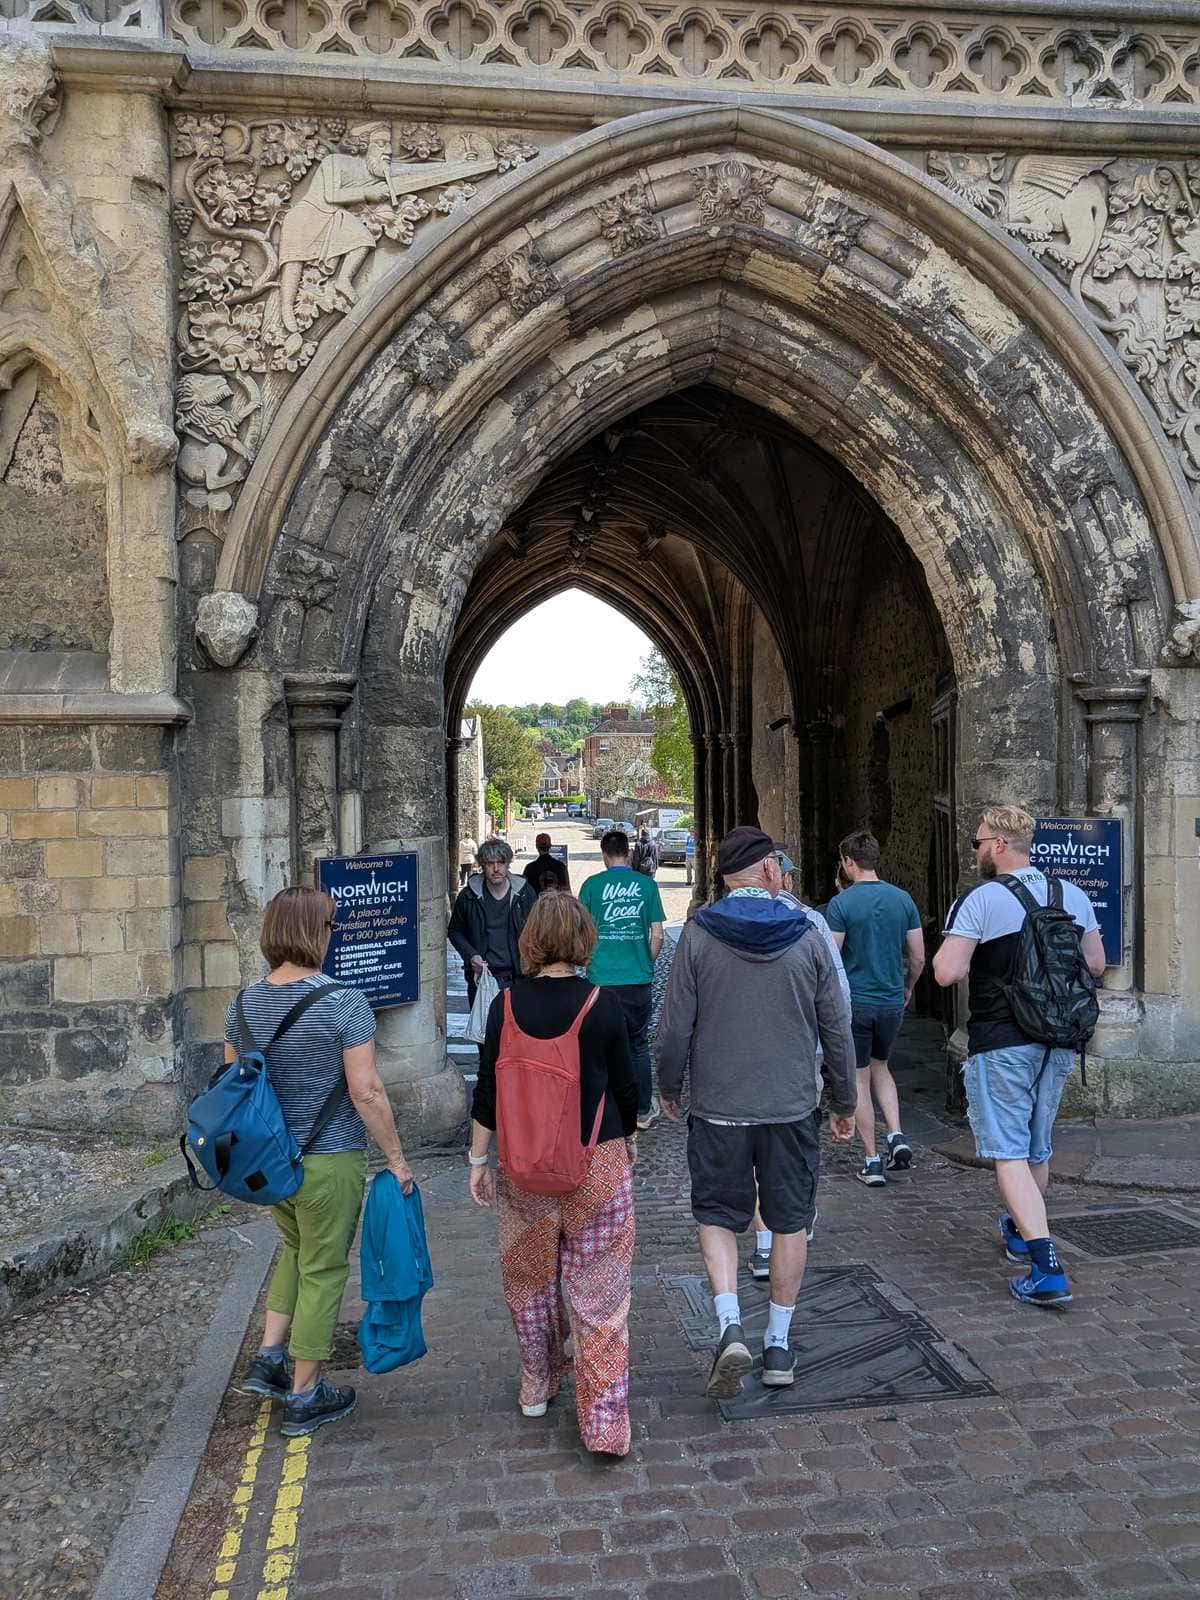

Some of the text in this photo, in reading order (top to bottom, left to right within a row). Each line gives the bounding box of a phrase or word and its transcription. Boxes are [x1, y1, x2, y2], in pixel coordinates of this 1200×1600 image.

[1040, 822, 1093, 831] Welcome to
[345, 859, 393, 871] Welcome to
[1029, 856, 1104, 865] CATHEDRAL
[1043, 866, 1091, 876] A place of
[331, 880, 409, 899] NORWICH
[1070, 878, 1109, 889] Worship
[602, 881, 642, 900] Walk
[335, 894, 404, 908] CATHEDRAL
[348, 906, 392, 919] A place of
[603, 900, 644, 921] Local
[333, 916, 408, 932] Christian Worship
[342, 928, 399, 942] for 900 years
[340, 938, 407, 953] CATHEDRAL CLOSE
[340, 949, 387, 961] EXHIBITIONS
[340, 957, 379, 969] GIFT SHOP
[340, 962, 403, 977] REFECTORY CAFE
[365, 975, 377, 983] and
[377, 972, 405, 981] Discover
